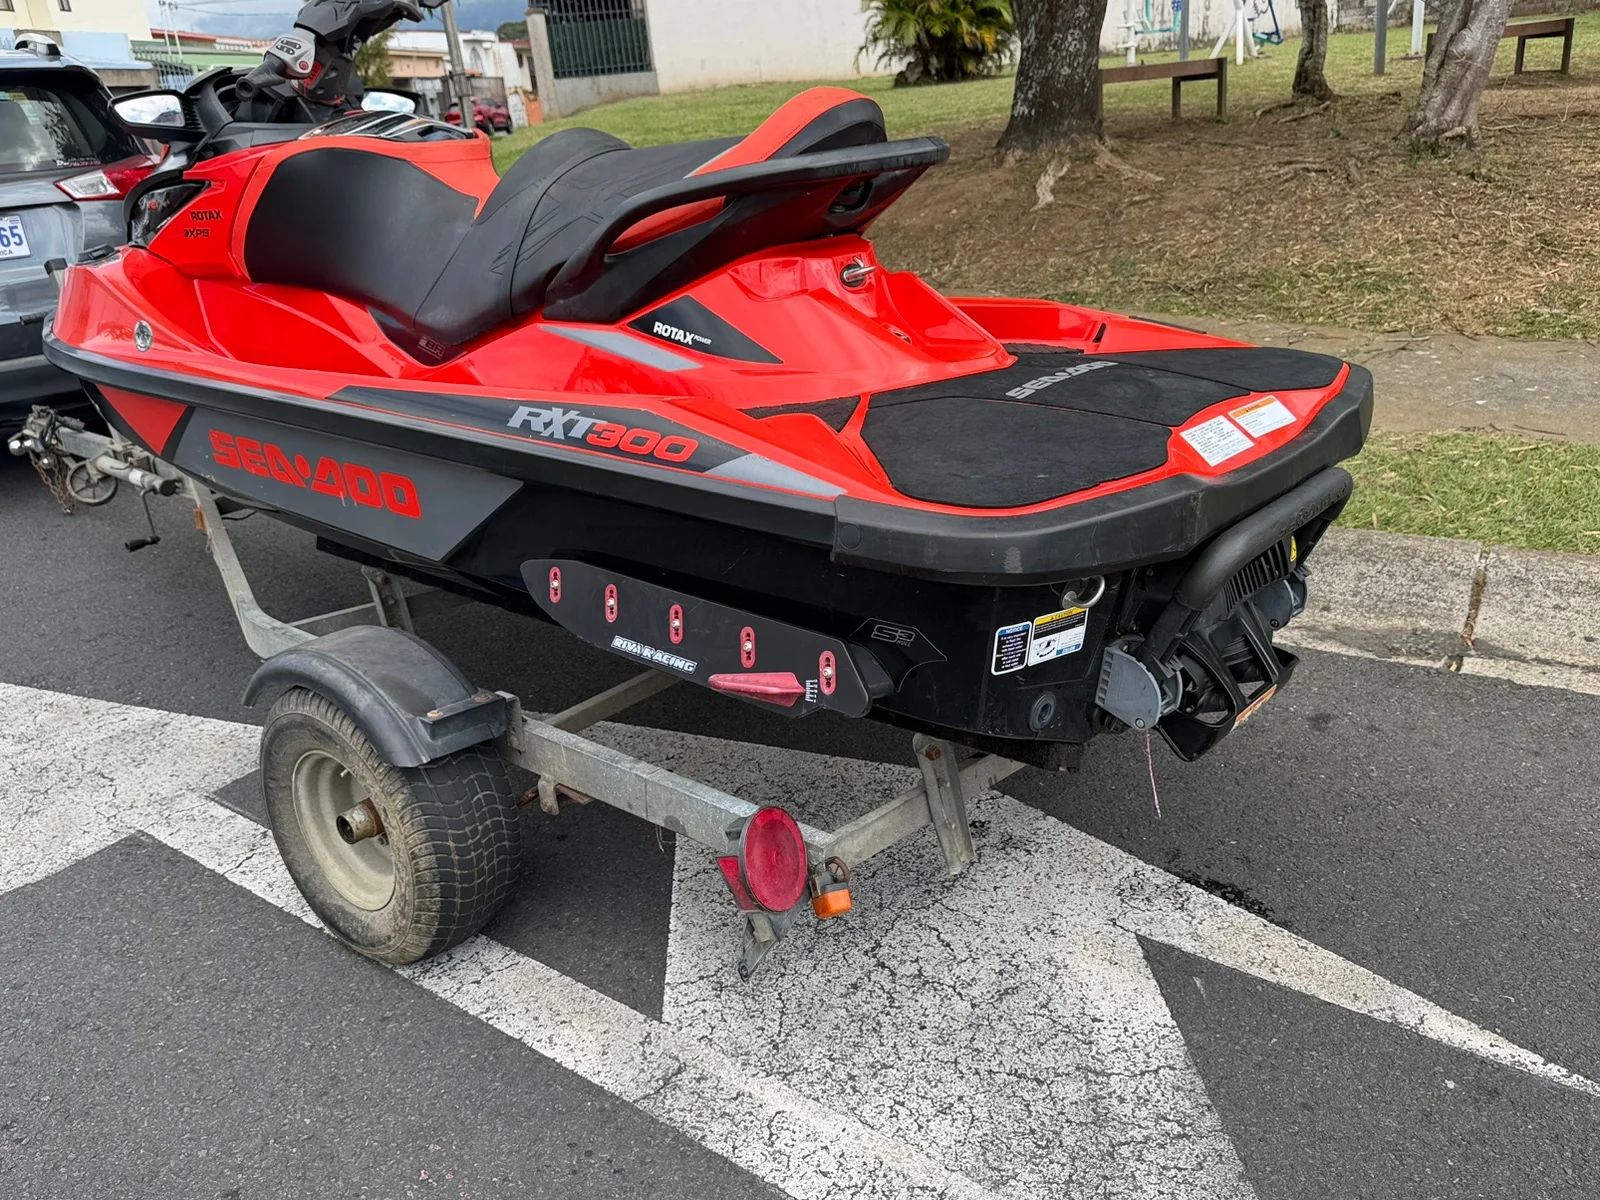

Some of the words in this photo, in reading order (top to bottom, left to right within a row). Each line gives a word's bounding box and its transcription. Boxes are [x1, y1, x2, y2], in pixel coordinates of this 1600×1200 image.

[190, 210, 223, 221] ROTAX
[653, 321, 694, 345] ROTAX
[871, 624, 916, 642] S3
[1006, 626, 1022, 634] NOTICE
[613, 637, 642, 655] RIVA
[642, 648, 694, 672] RACING
